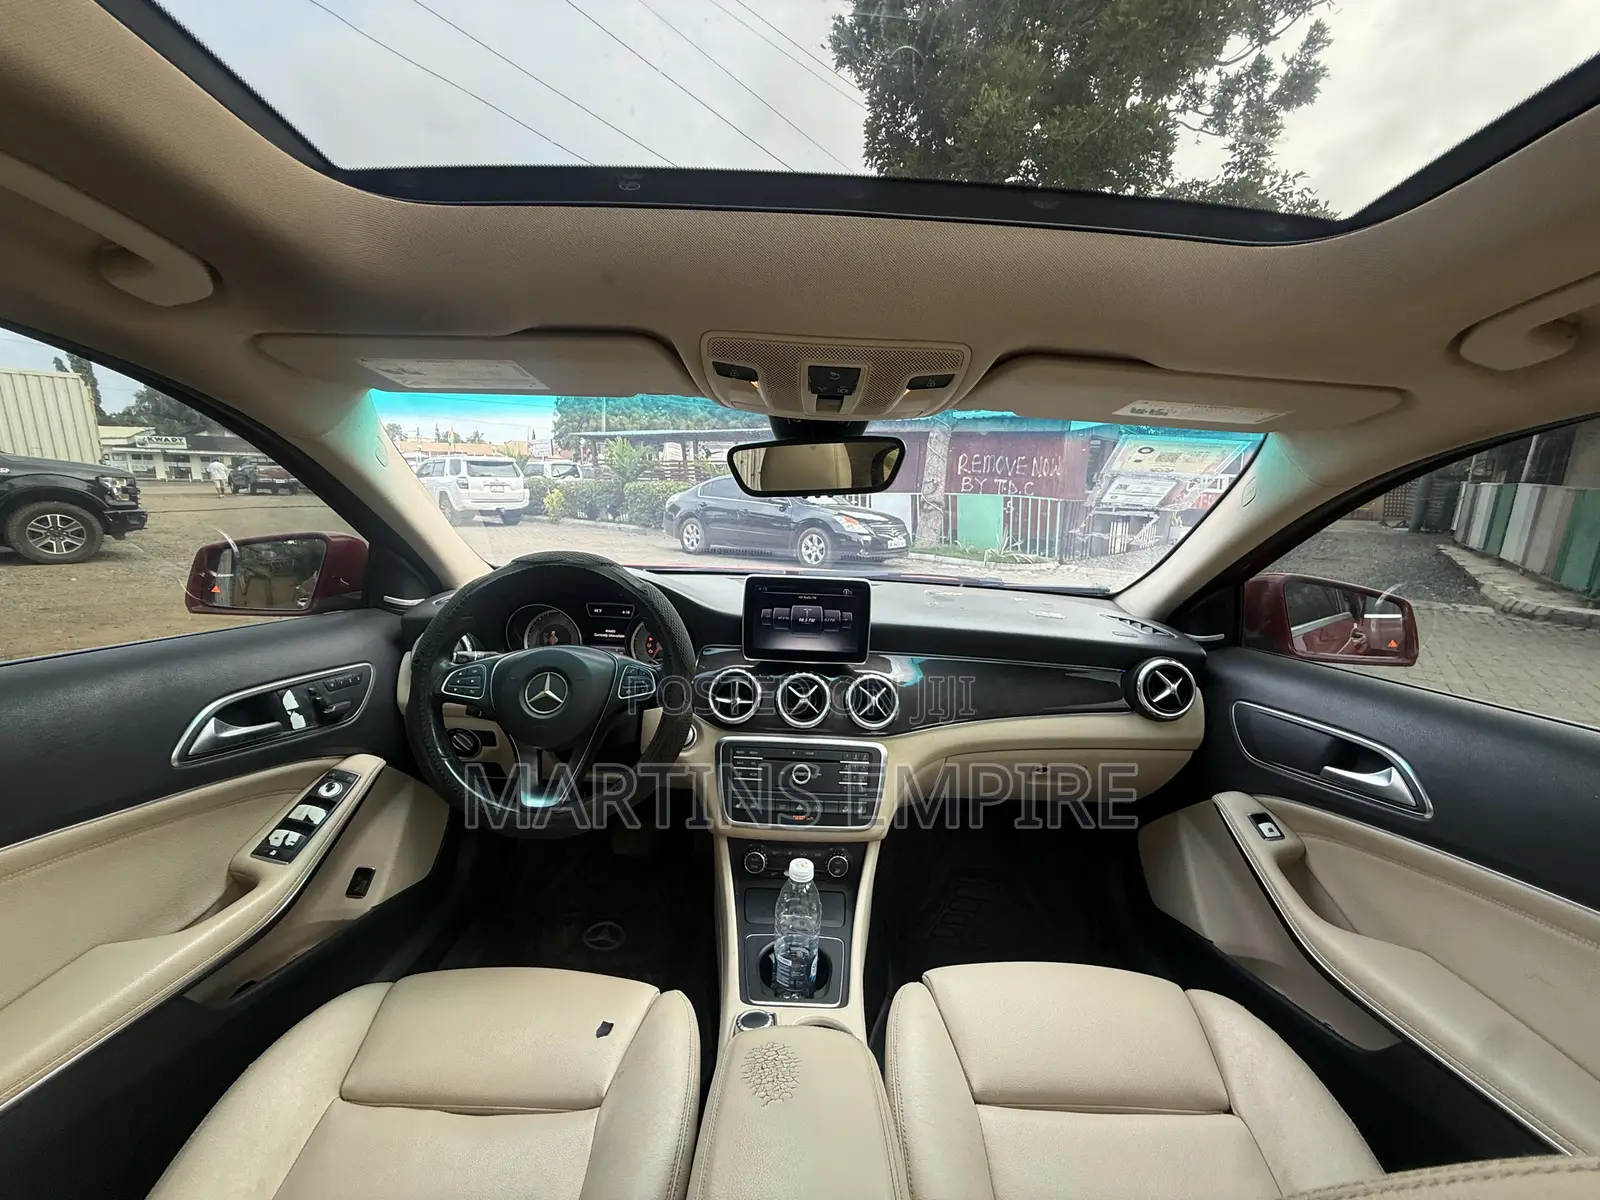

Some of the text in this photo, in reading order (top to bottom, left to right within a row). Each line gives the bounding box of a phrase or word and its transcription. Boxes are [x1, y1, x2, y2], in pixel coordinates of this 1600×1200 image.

[957, 453, 1062, 477] REMOVE NOW
[960, 476, 988, 495] BY
